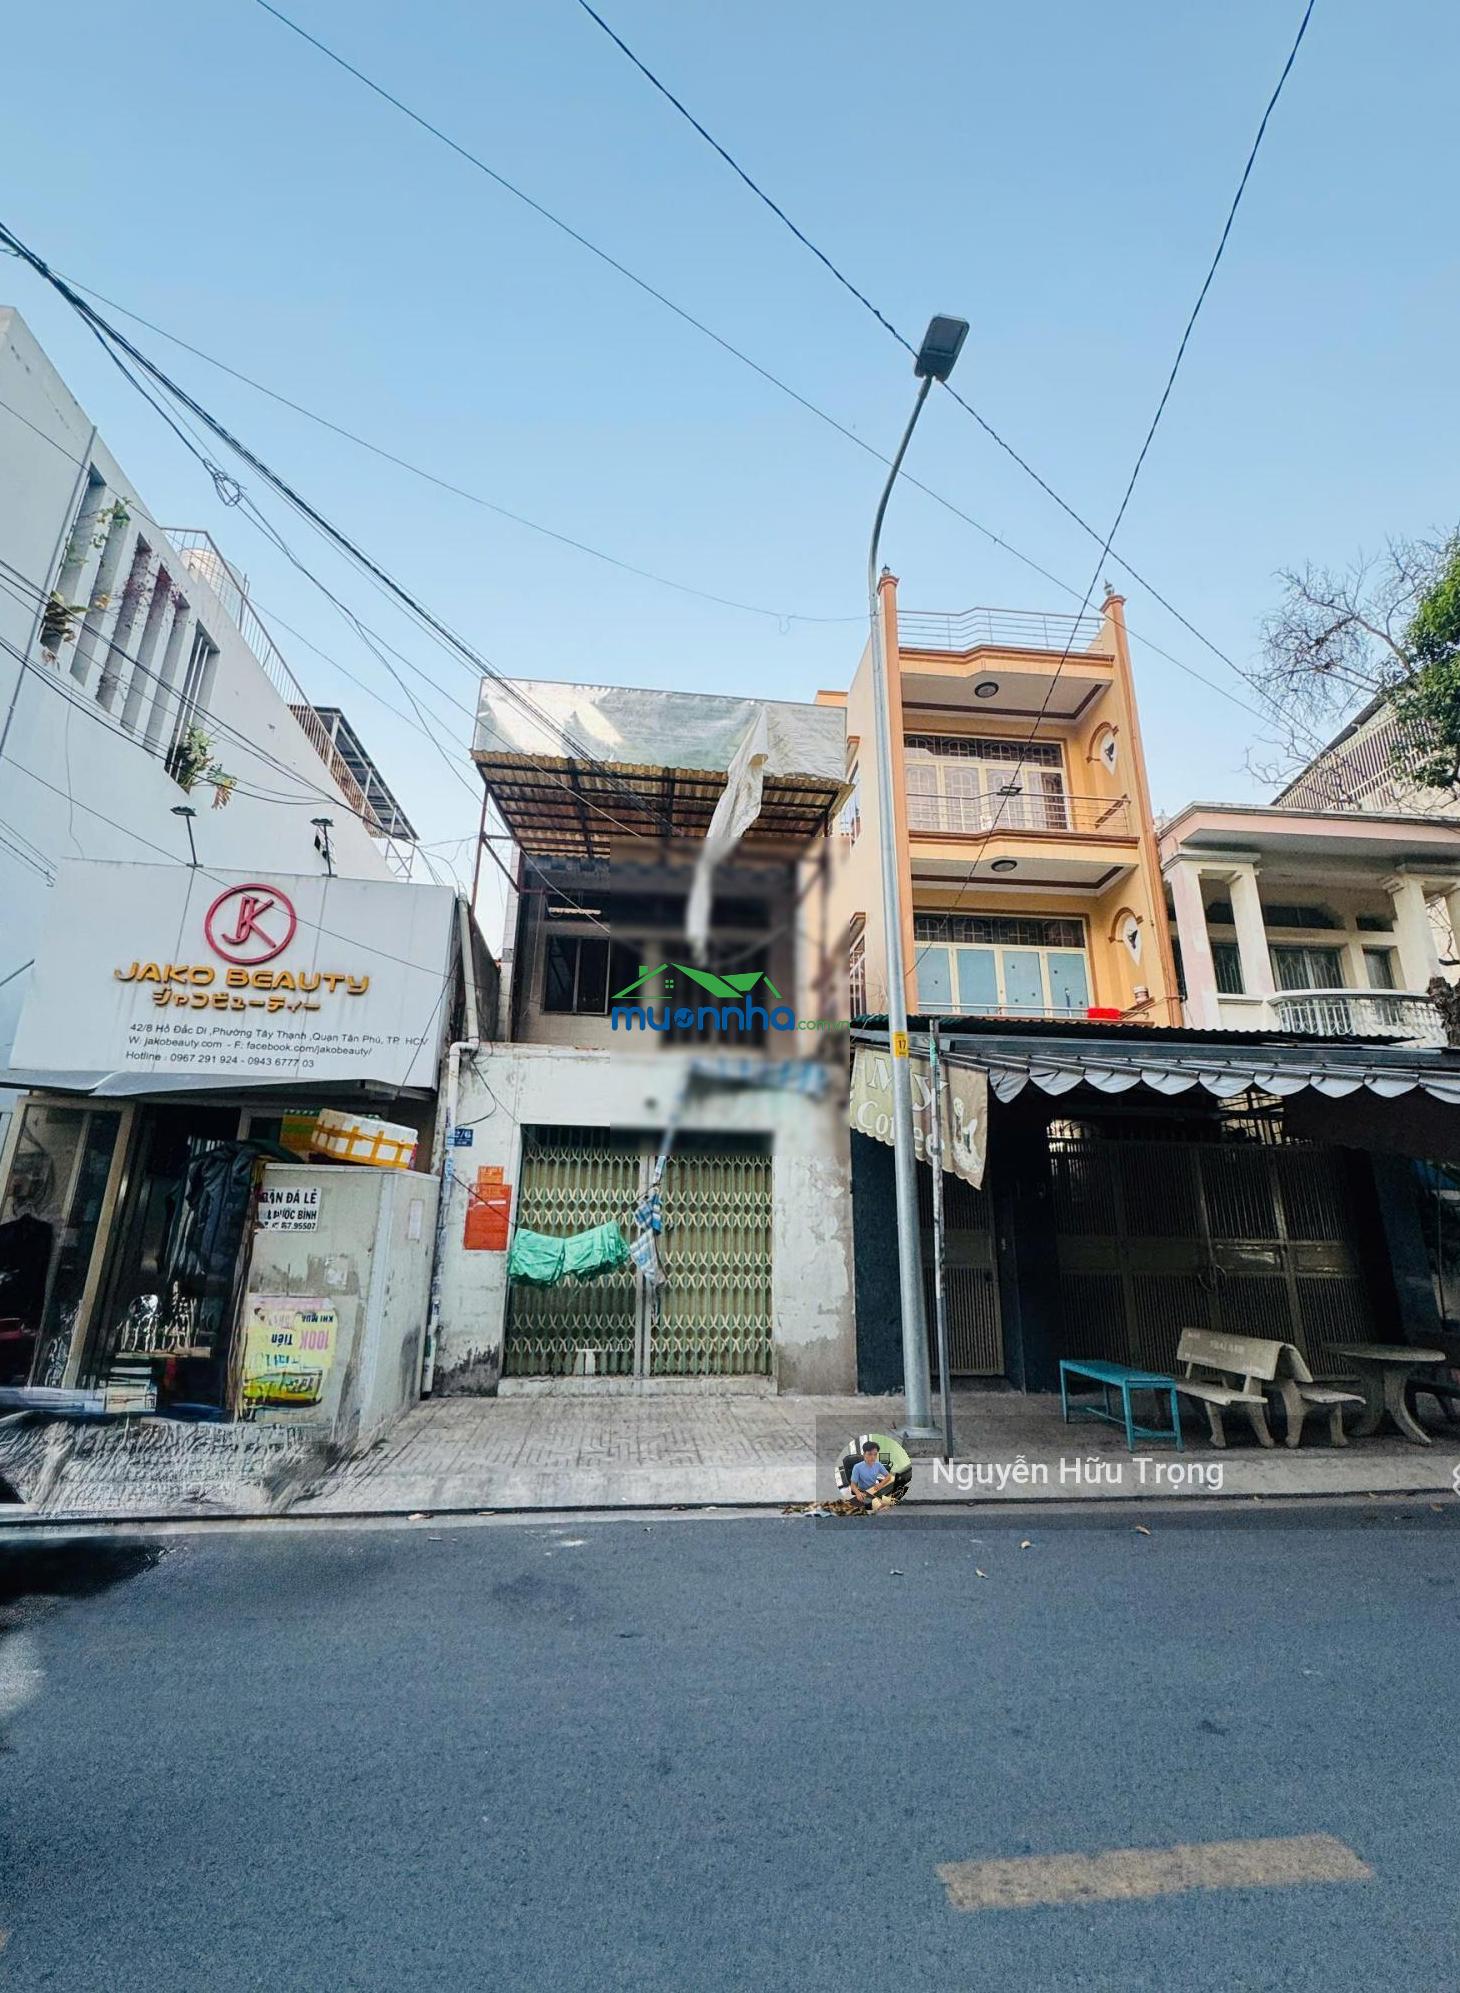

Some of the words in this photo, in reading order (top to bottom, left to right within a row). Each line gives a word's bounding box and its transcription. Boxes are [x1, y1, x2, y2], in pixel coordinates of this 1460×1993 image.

[114, 962, 216, 986] JAKO
[226, 968, 370, 995] BEAUTY
[130, 1023, 153, 1033] 42/8
[256, 1029, 273, 1039] Tây
[277, 1030, 307, 1040] Thạnh
[342, 1034, 359, 1043] Tân
[126, 1051, 161, 1061] Hotline
[170, 1053, 196, 1062] 0967
[198, 1054, 216, 1063] 291
[219, 1055, 238, 1064] 924
[247, 1056, 272, 1066] 0943
[274, 1058, 300, 1067] 6777
[302, 1059, 314, 1068] 03
[857, 1101, 945, 1158] Coee
